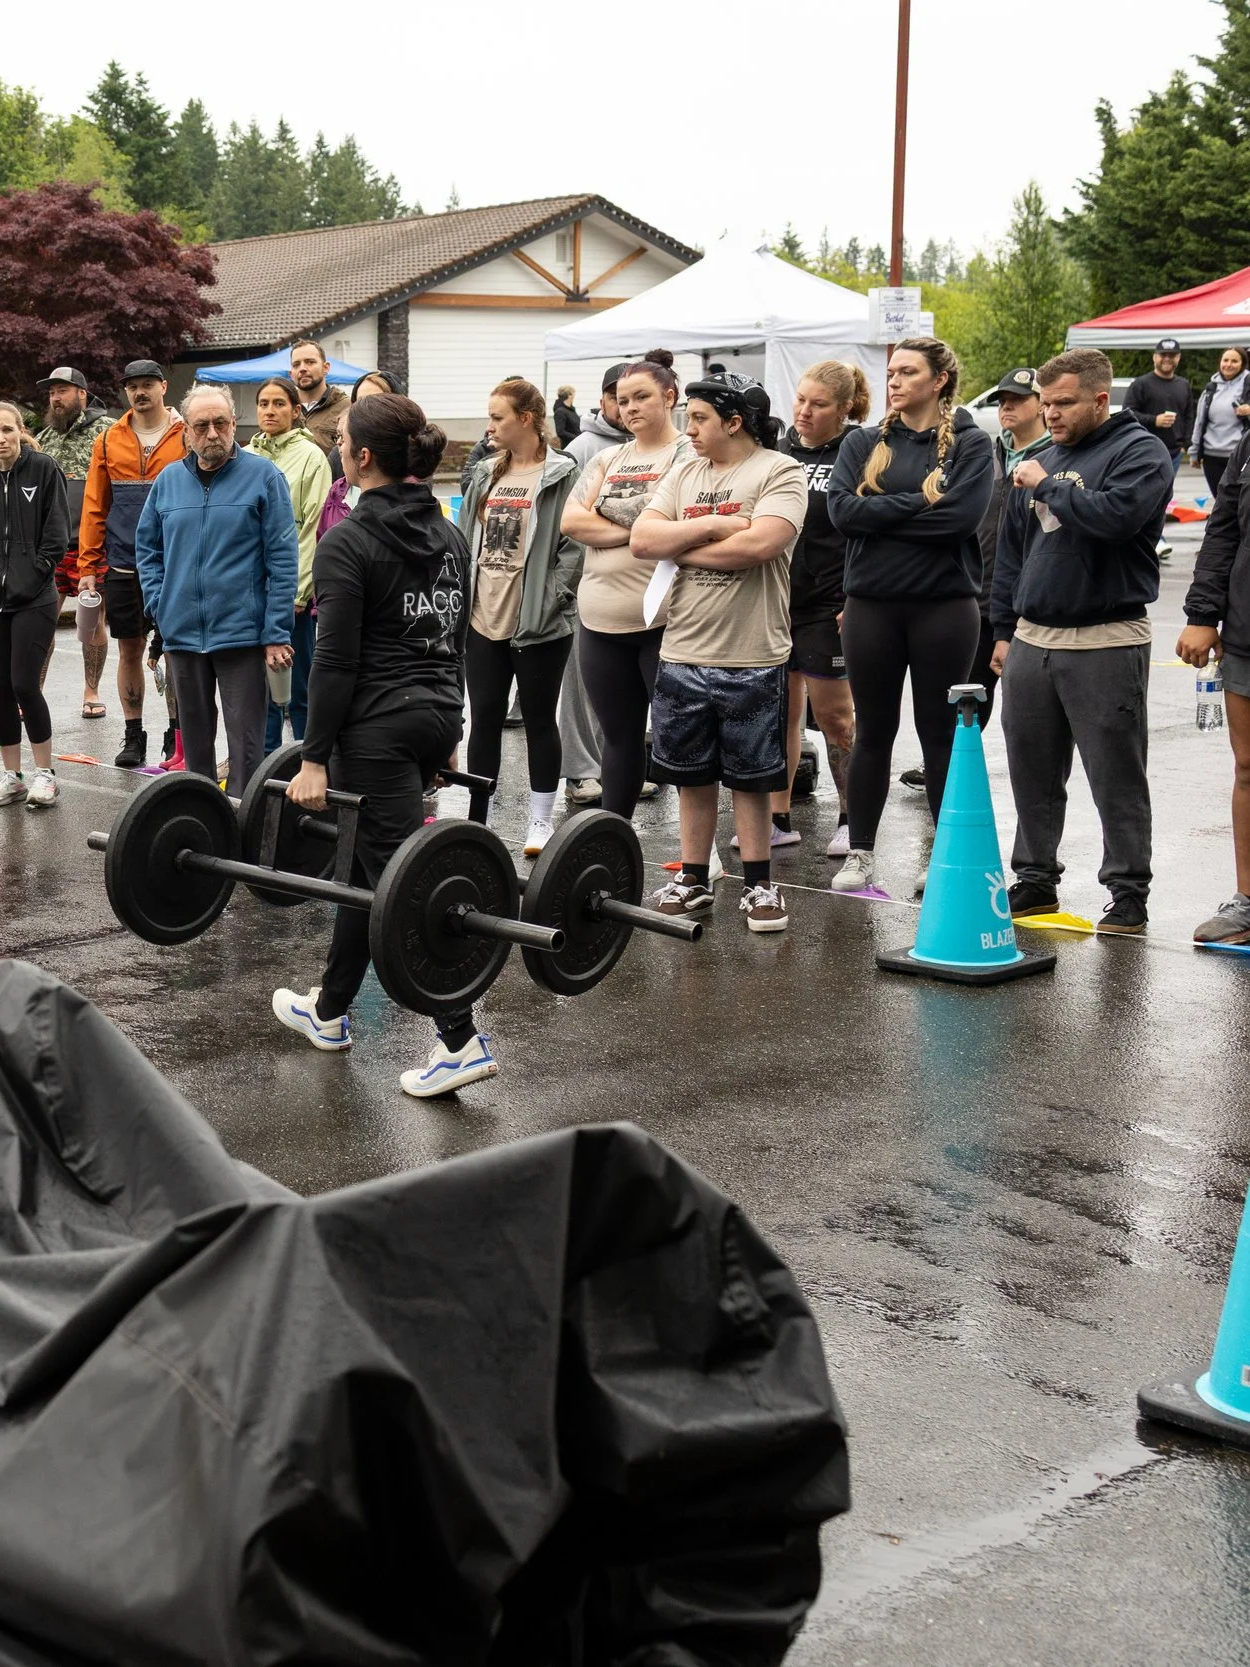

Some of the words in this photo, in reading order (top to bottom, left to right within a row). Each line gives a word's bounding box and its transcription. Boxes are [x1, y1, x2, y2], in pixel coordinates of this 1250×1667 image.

[617, 463, 656, 474] SAMSON
[495, 487, 529, 498] SAMSON
[403, 590, 463, 617] RACC
[980, 927, 1017, 950] BLAZE
